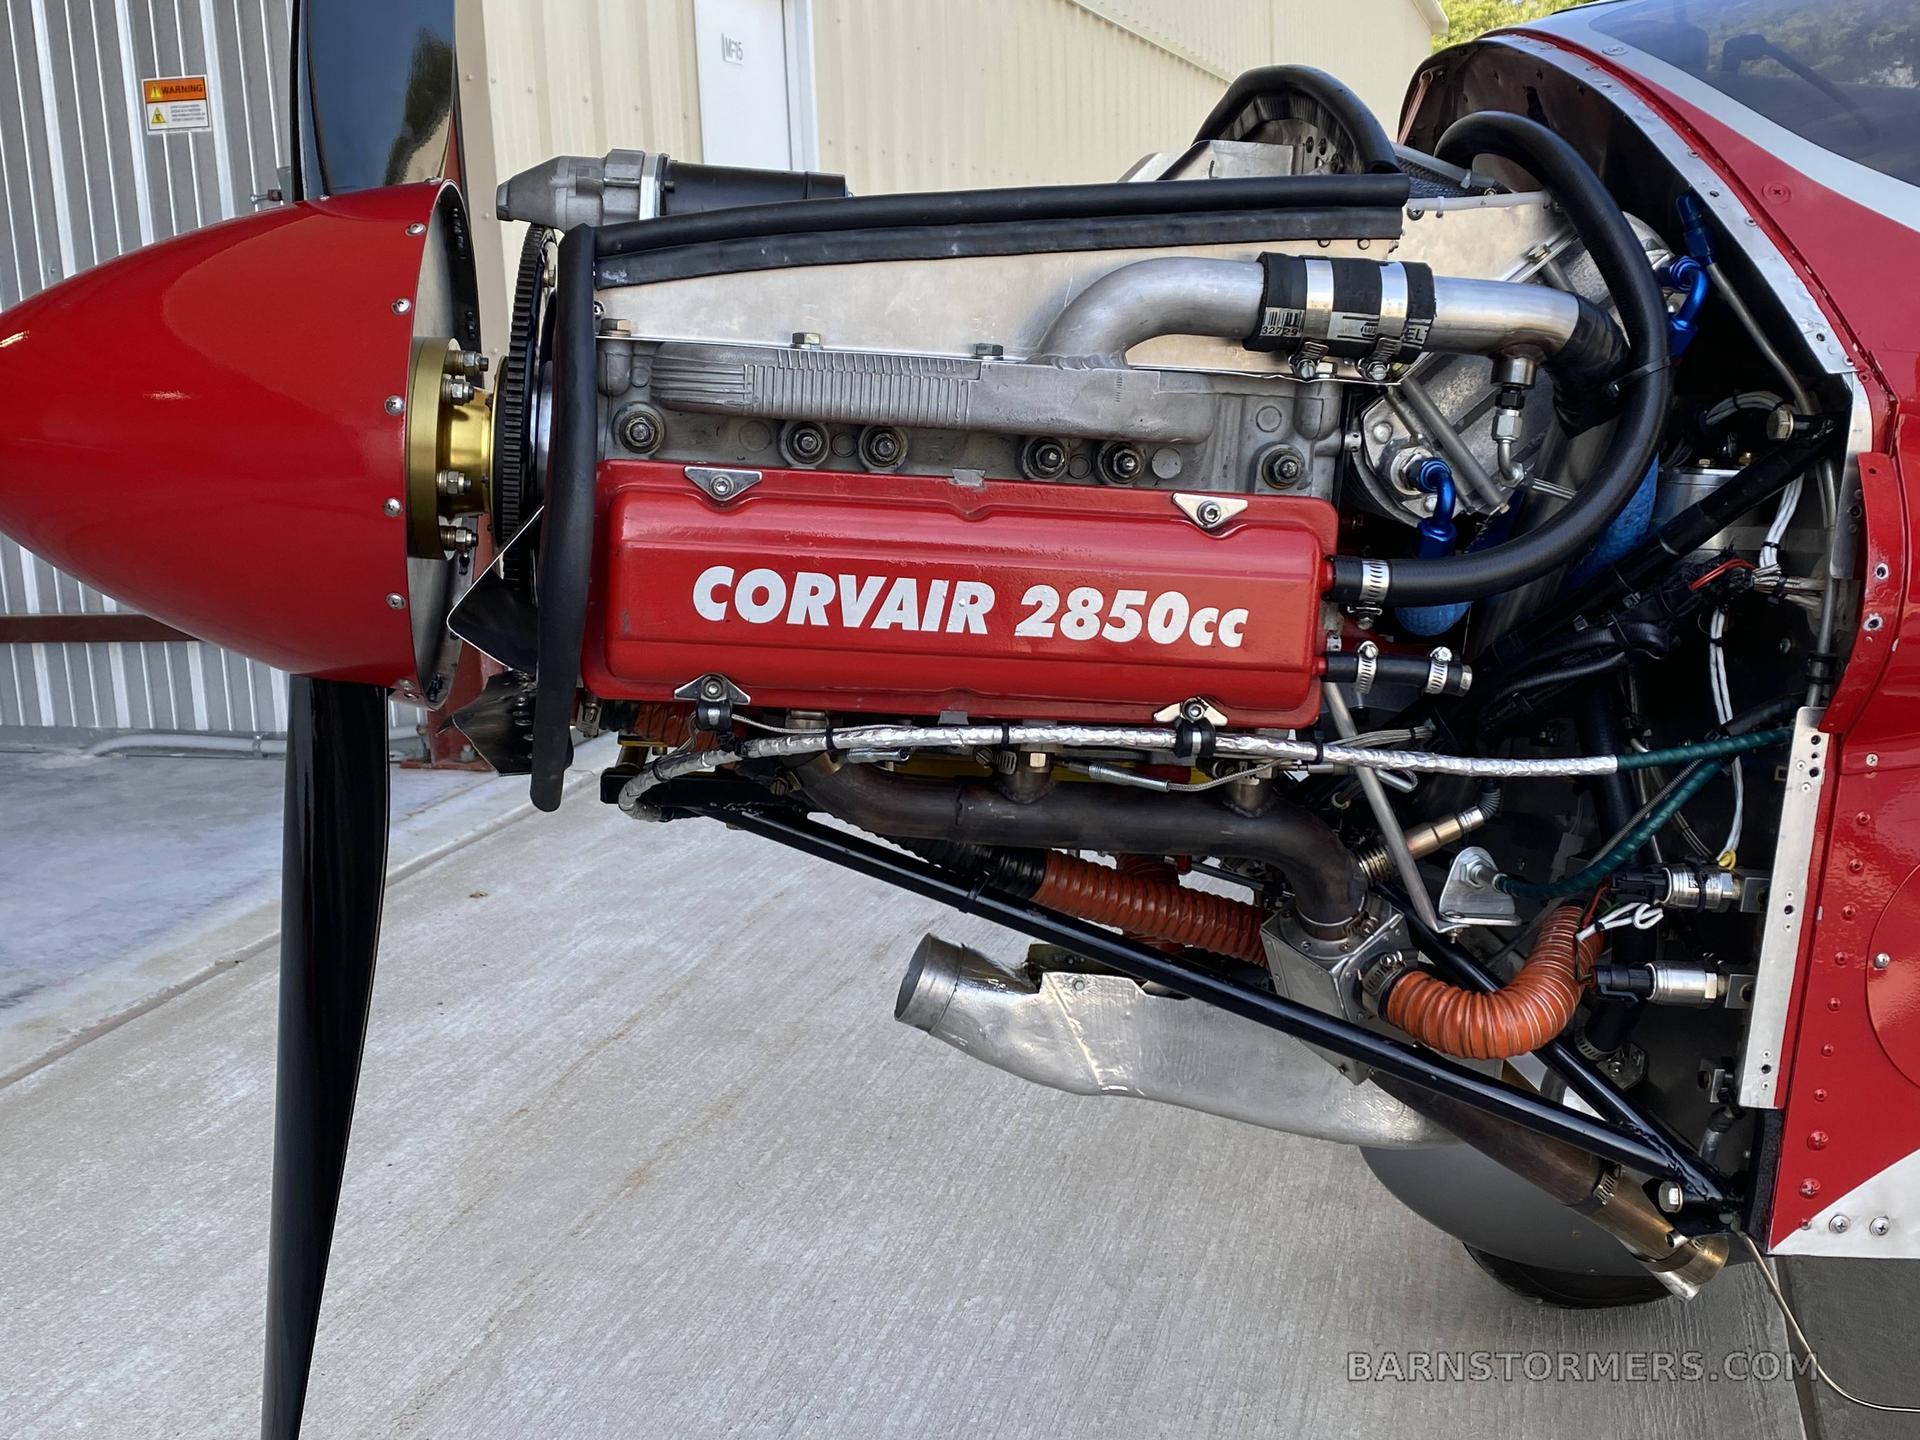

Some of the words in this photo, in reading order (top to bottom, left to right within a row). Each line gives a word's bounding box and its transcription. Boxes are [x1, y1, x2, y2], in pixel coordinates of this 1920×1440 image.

[162, 84, 203, 95] WARNING
[693, 565, 996, 634] CORVAIR
[1014, 584, 1250, 648] 2850cc
